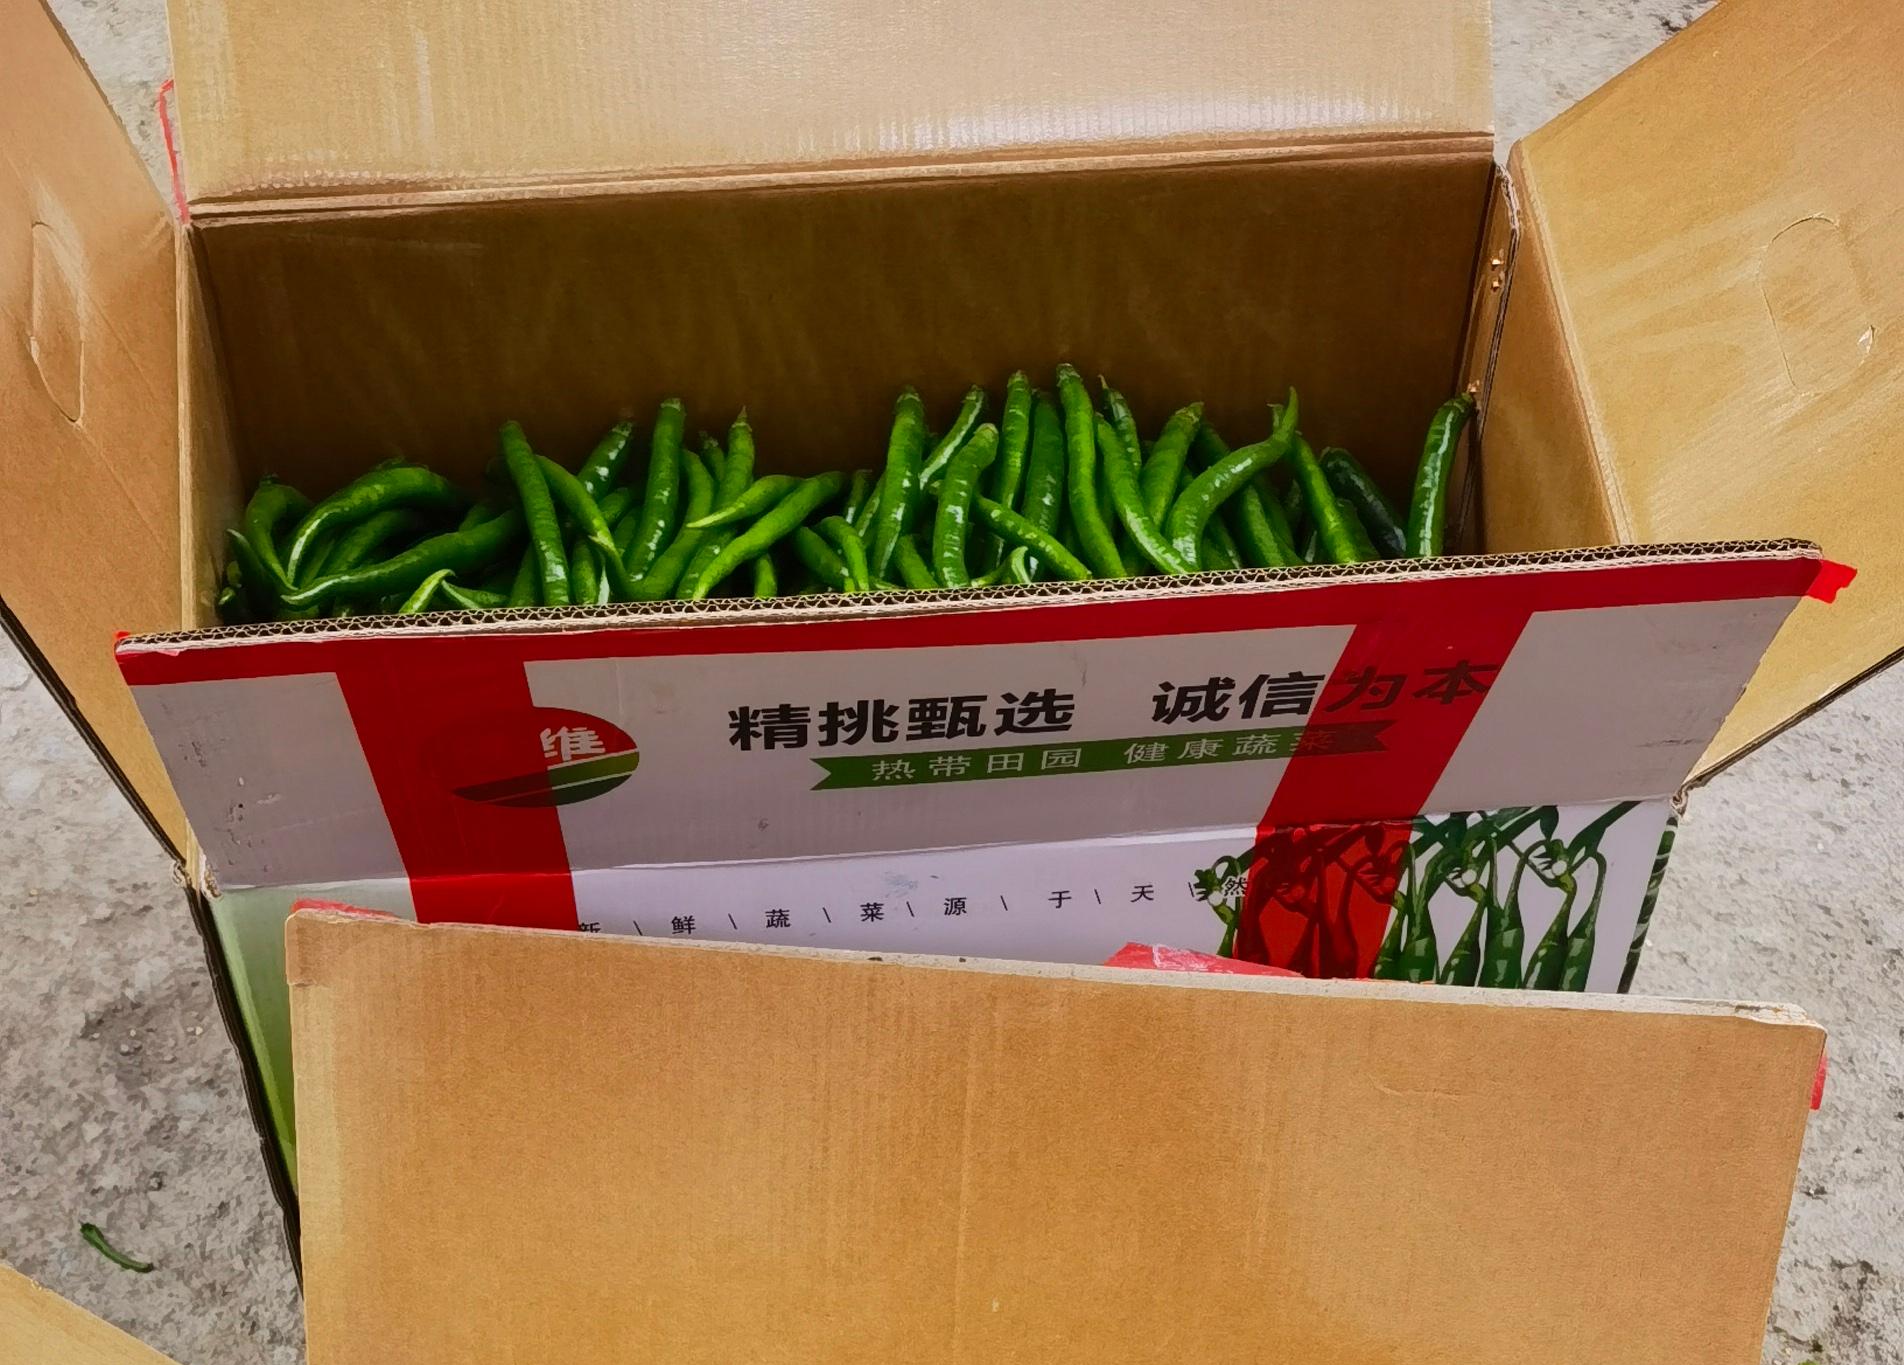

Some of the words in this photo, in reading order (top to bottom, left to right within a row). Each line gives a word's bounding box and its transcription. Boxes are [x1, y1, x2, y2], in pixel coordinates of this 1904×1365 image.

[728, 688, 1075, 751] 精挑甄选
[1152, 659, 1501, 725] 诚信为本
[539, 726, 606, 762] 维
[871, 747, 1082, 781] 热带田园
[1123, 731, 1338, 765] 健康蔬菜
